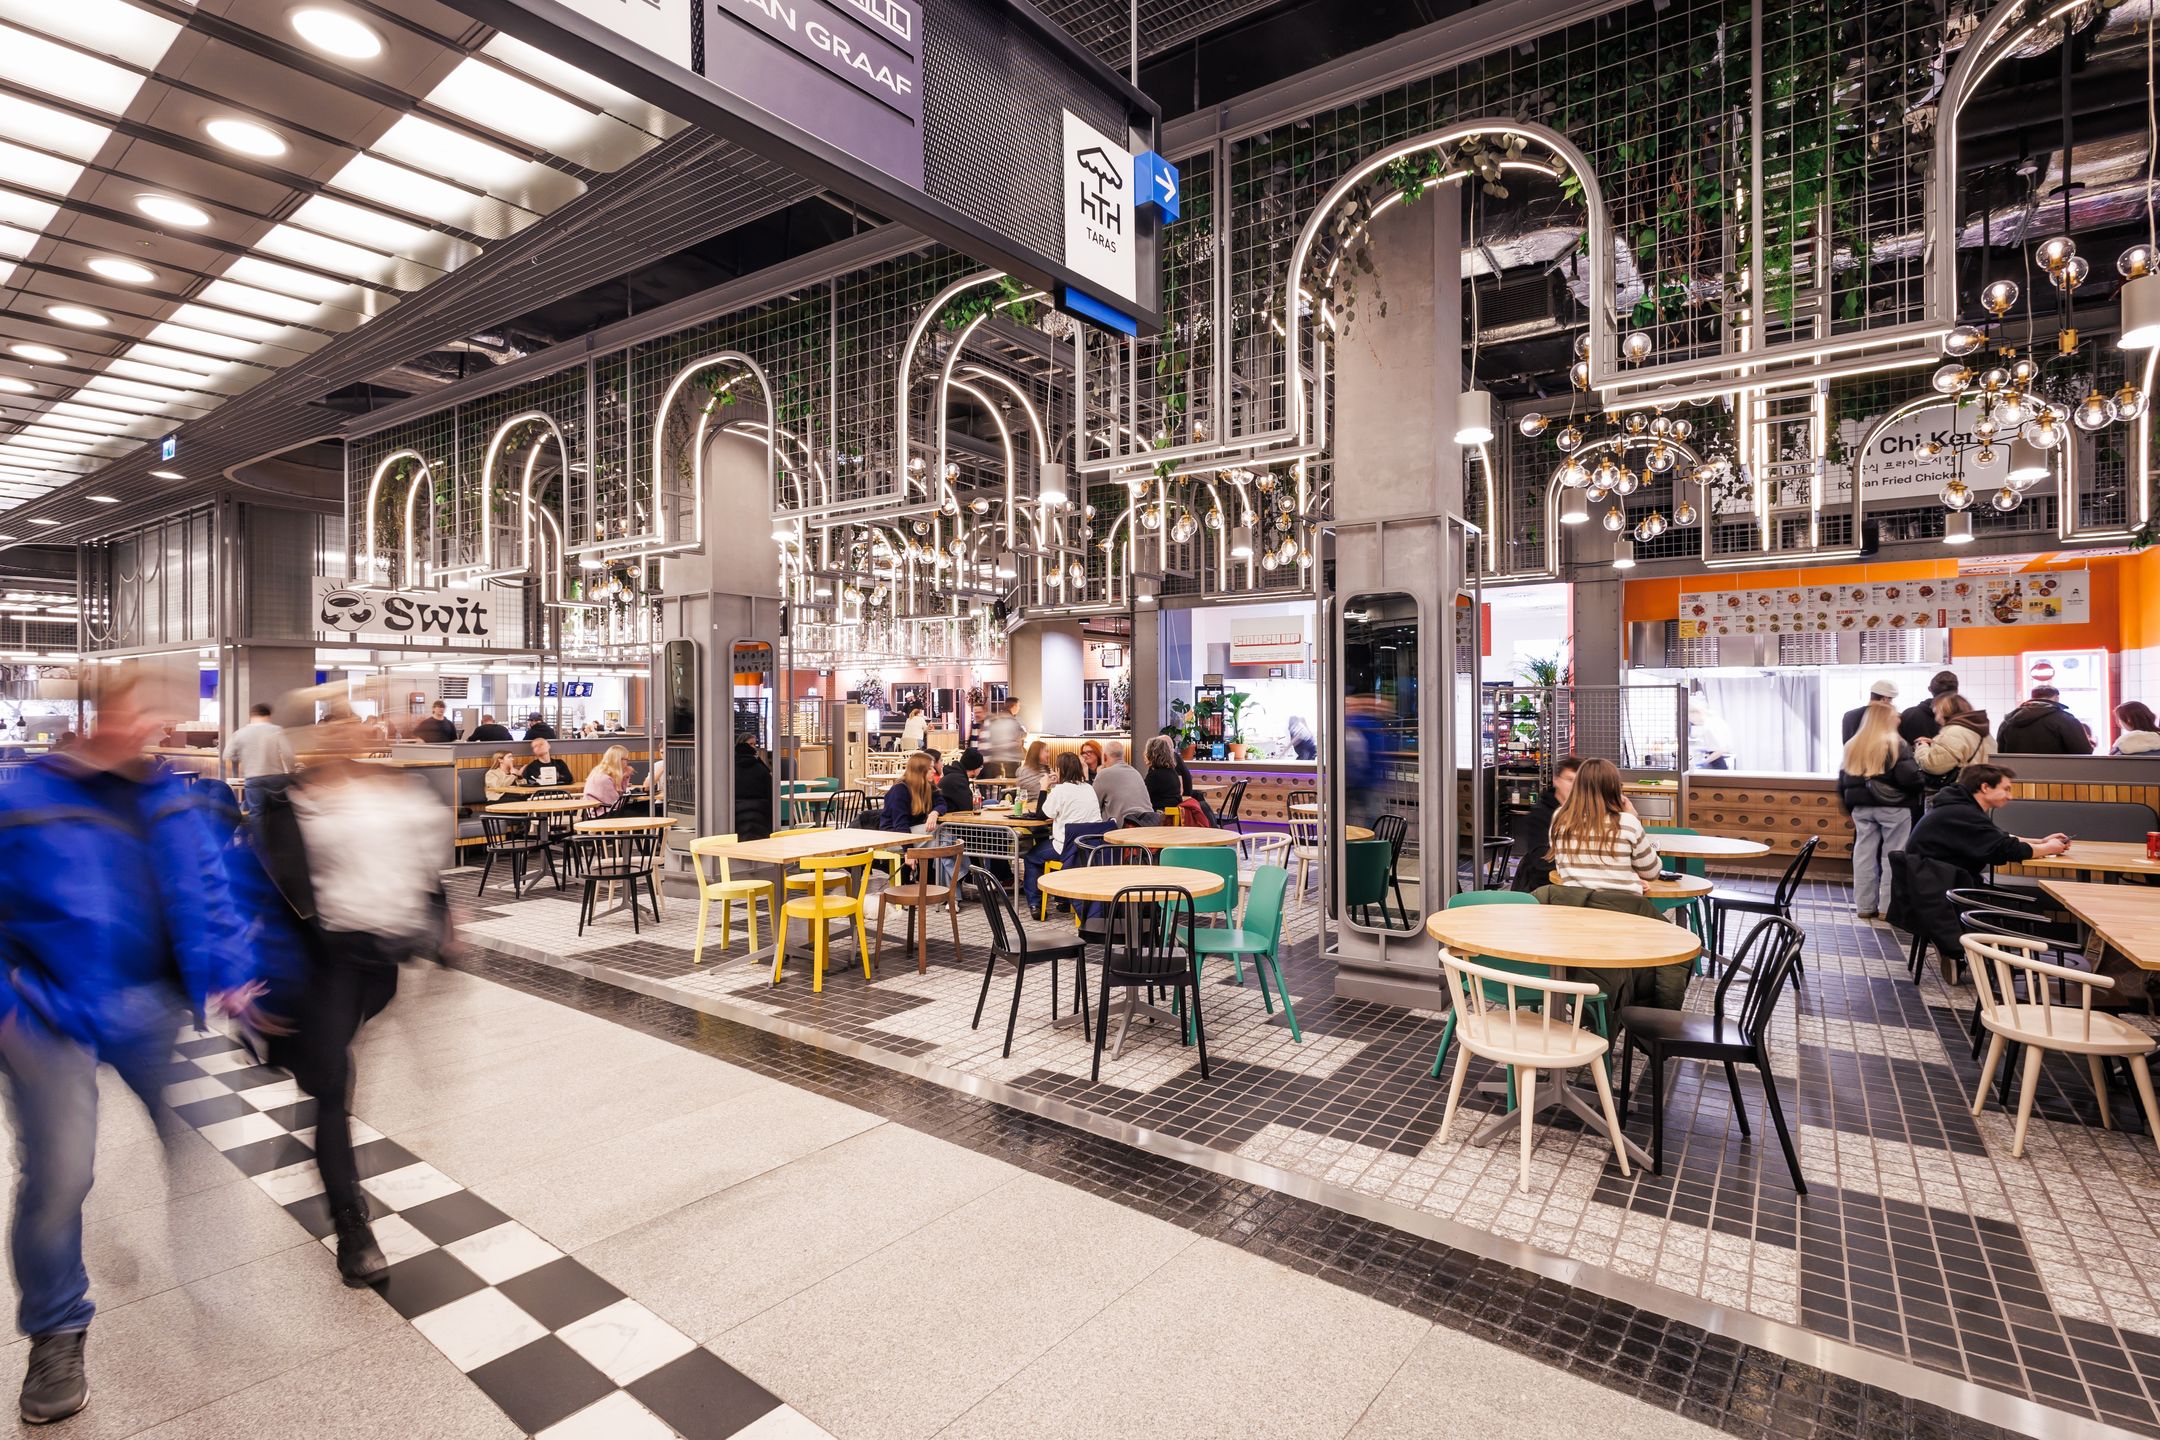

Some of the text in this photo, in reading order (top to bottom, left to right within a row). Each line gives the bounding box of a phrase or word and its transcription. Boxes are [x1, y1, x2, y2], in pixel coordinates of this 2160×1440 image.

[805, 21, 912, 95] GRAAF
[1086, 227, 1117, 253] TARAS
[1880, 433, 1921, 454] Chi
[1882, 473, 1912, 486] Fried
[1915, 470, 1965, 483] Chicken
[384, 597, 489, 635] Swit
